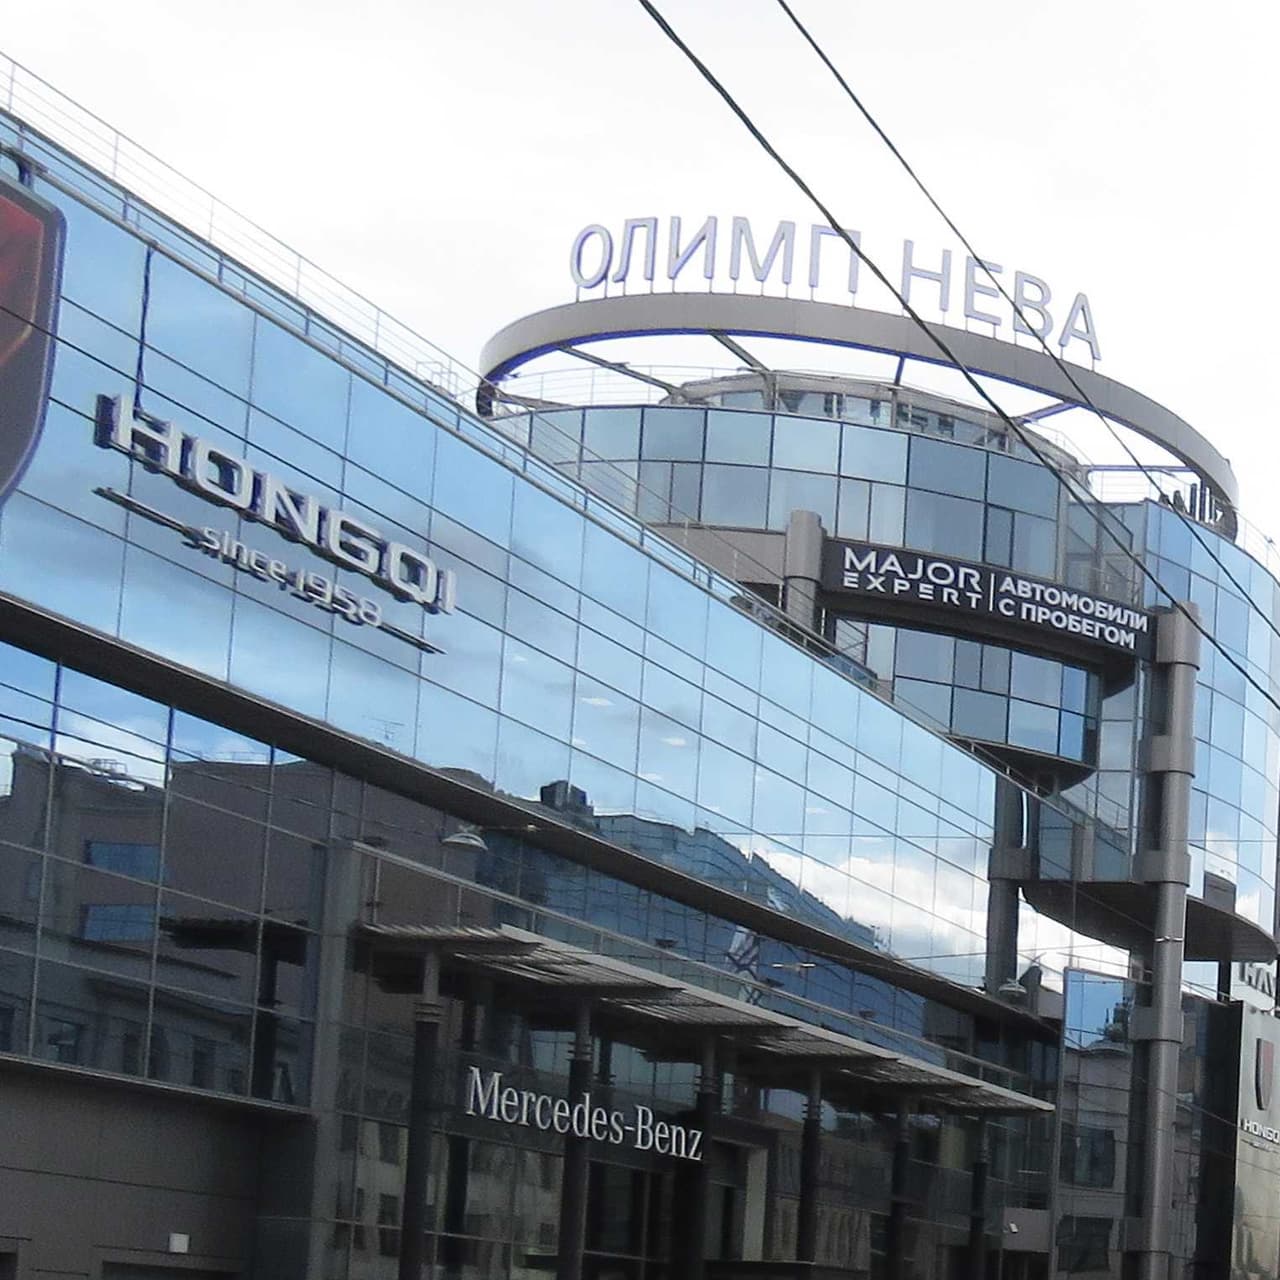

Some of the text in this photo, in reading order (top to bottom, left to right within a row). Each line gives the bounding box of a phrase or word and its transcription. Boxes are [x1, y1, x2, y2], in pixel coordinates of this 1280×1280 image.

[569, 216, 1101, 360] ОЛИМП НЕВА
[96, 392, 457, 615] HONGQI
[199, 526, 383, 627] since 1958
[843, 571, 983, 609] EXPERT
[844, 547, 983, 592] MAJOR
[999, 576, 1148, 633] АВТОМОБИЛИ
[999, 598, 1136, 649] С ПРОБЕГОМ
[465, 1066, 703, 1161] Mercedes-Benz
